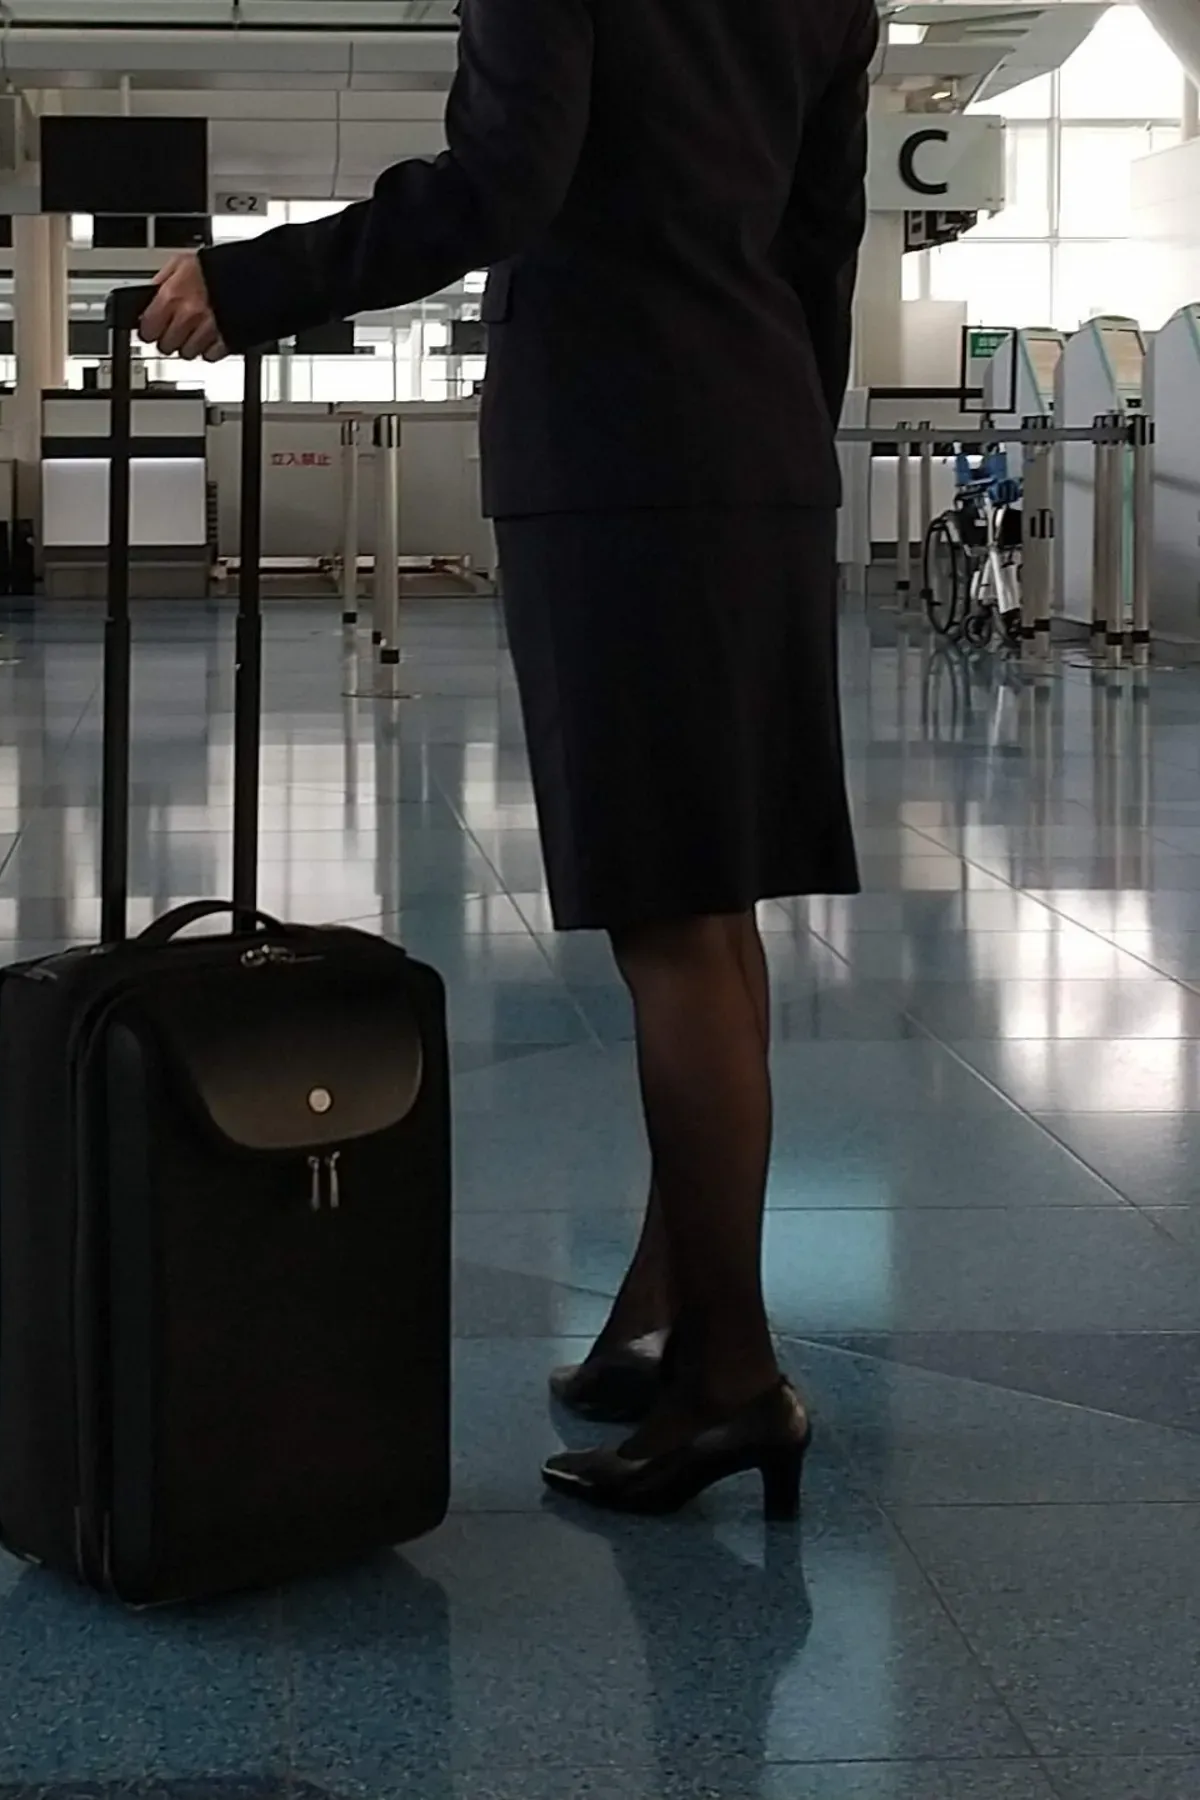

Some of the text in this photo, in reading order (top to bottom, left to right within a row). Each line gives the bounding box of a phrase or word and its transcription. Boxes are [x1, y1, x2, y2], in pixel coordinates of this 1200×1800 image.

[898, 129, 949, 195] C
[225, 196, 258, 212] C-2
[271, 452, 332, 466] 立入禁止
